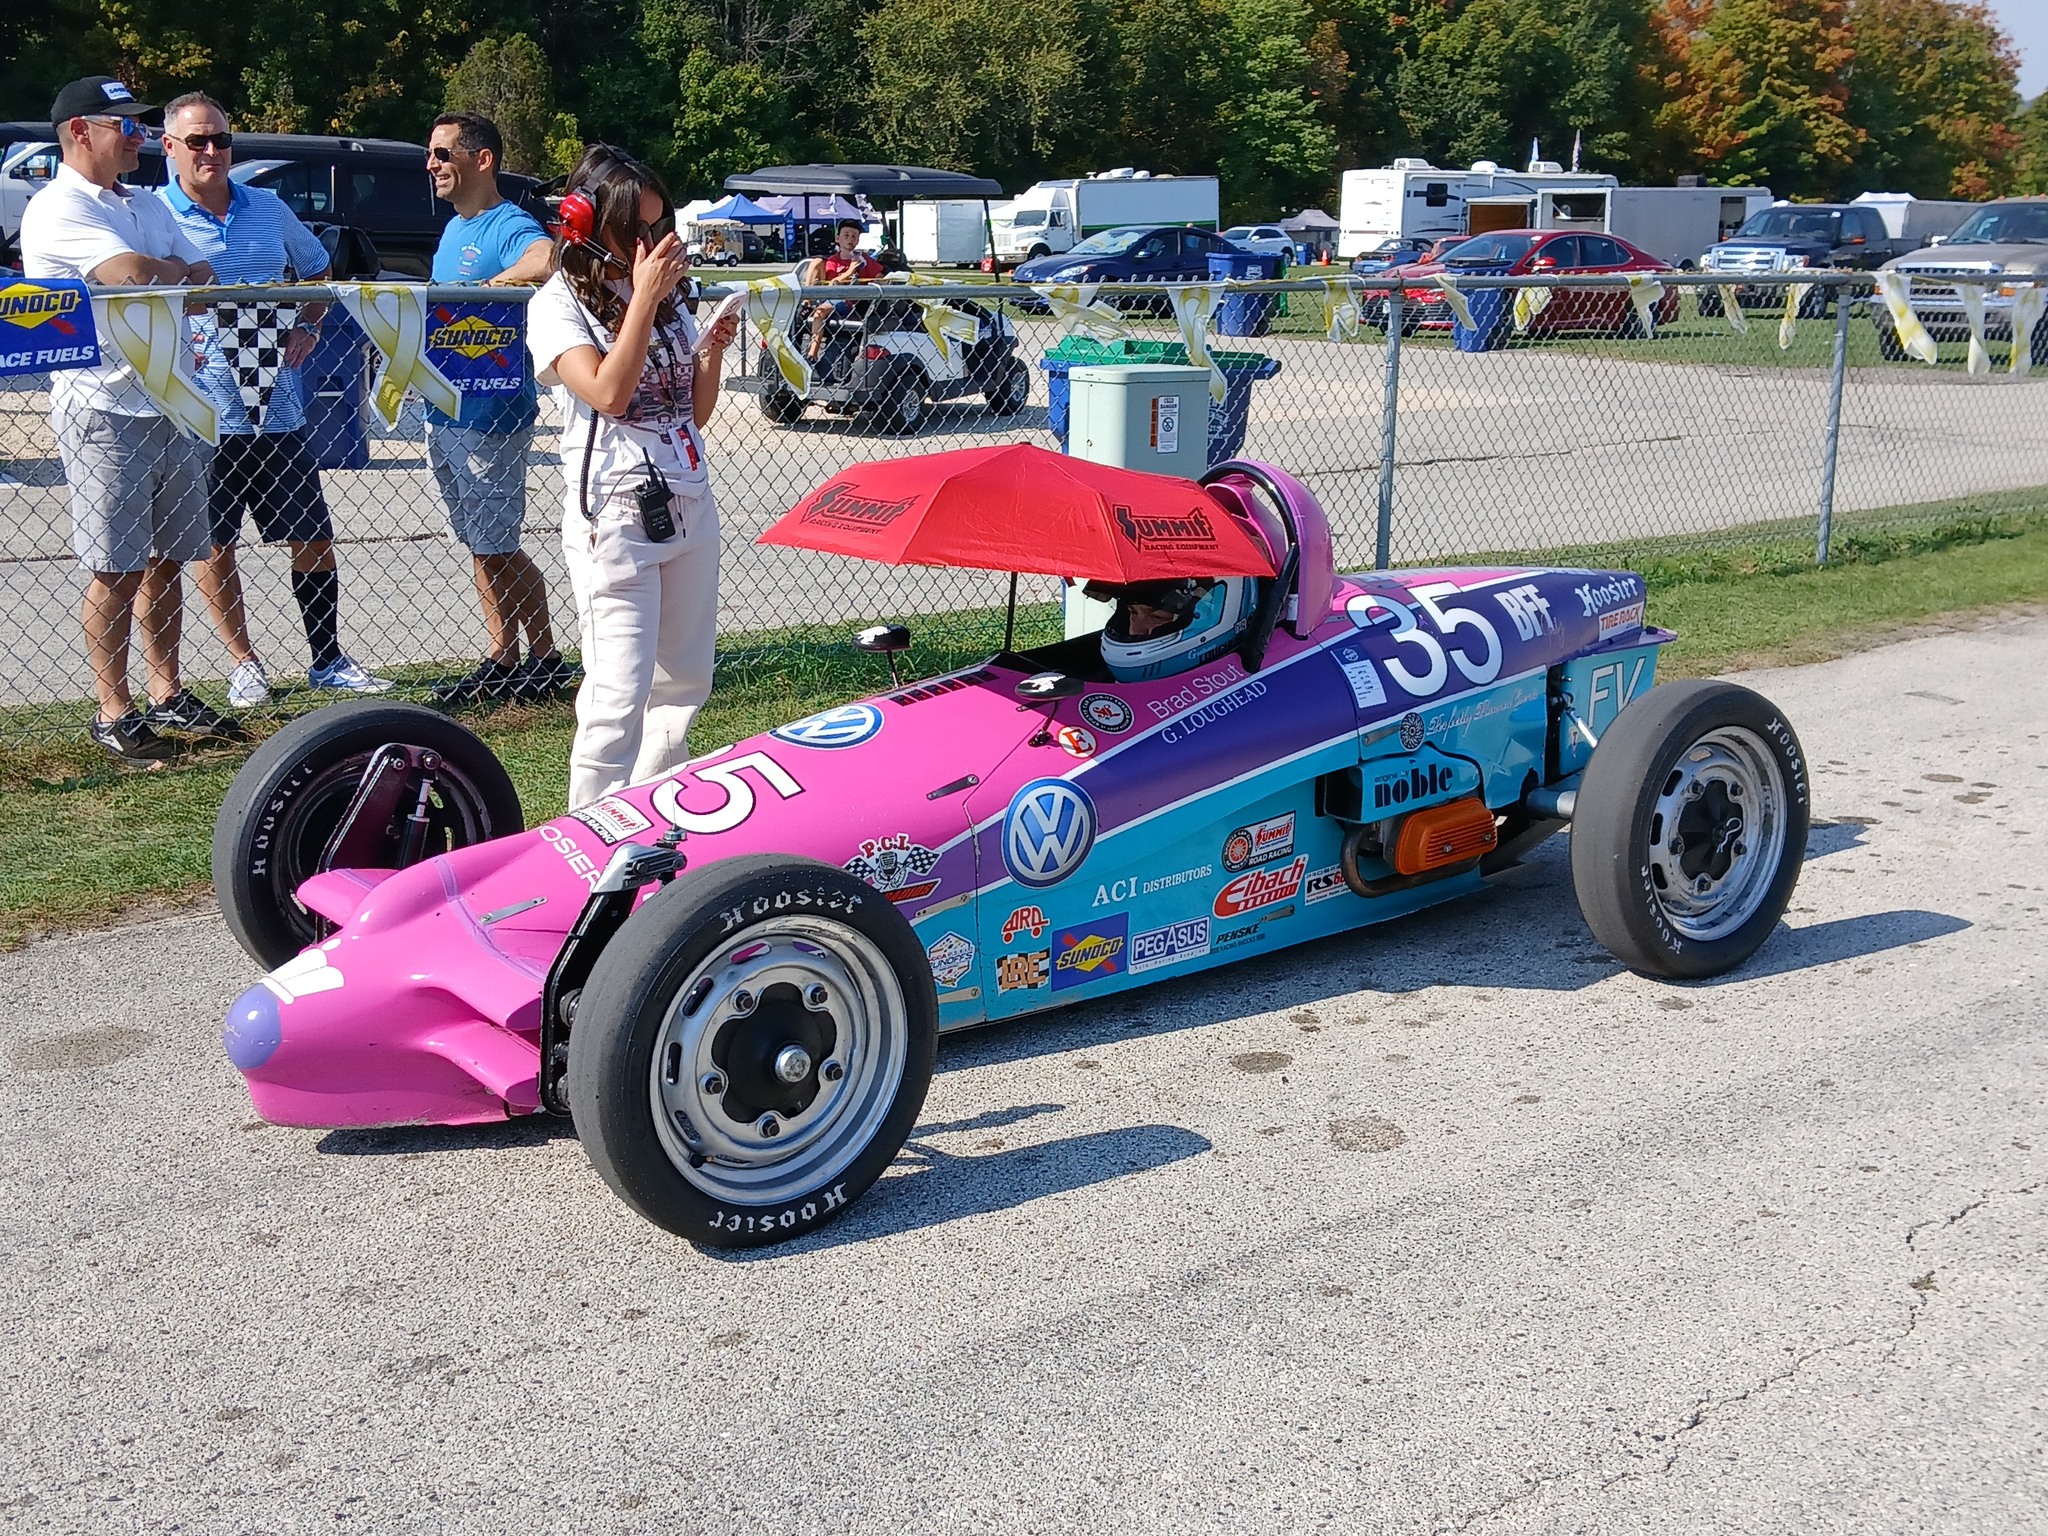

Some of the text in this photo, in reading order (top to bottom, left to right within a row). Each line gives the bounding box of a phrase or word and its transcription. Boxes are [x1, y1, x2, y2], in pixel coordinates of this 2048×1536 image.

[0, 292, 75, 316] UNOCO
[0, 345, 95, 368] ACE FUELS
[434, 329, 513, 346] SUNOCO
[452, 378, 521, 391] CE FUELS
[1575, 576, 1638, 617] Hoosier
[1601, 605, 1641, 631] TIRE RACK
[1347, 582, 1503, 697] 35
[1147, 664, 1244, 719] Brad Stout
[1588, 656, 1646, 729] FV
[1161, 681, 1267, 744] G. LOUGHEAD
[650, 751, 806, 834] 5
[1375, 763, 1453, 809] noble
[586, 817, 616, 844] RACING
[1249, 854, 1268, 866] ROAD
[1268, 845, 1292, 859] RACING
[1092, 864, 1212, 907] ACI DISTRIBUTORS
[1217, 859, 1304, 906] Eibach
[719, 887, 863, 933] Hoosier
[1135, 922, 1207, 959] PEGASUS
[1216, 923, 1261, 944] PENSKE
[1059, 939, 1119, 968] SUNOCO
